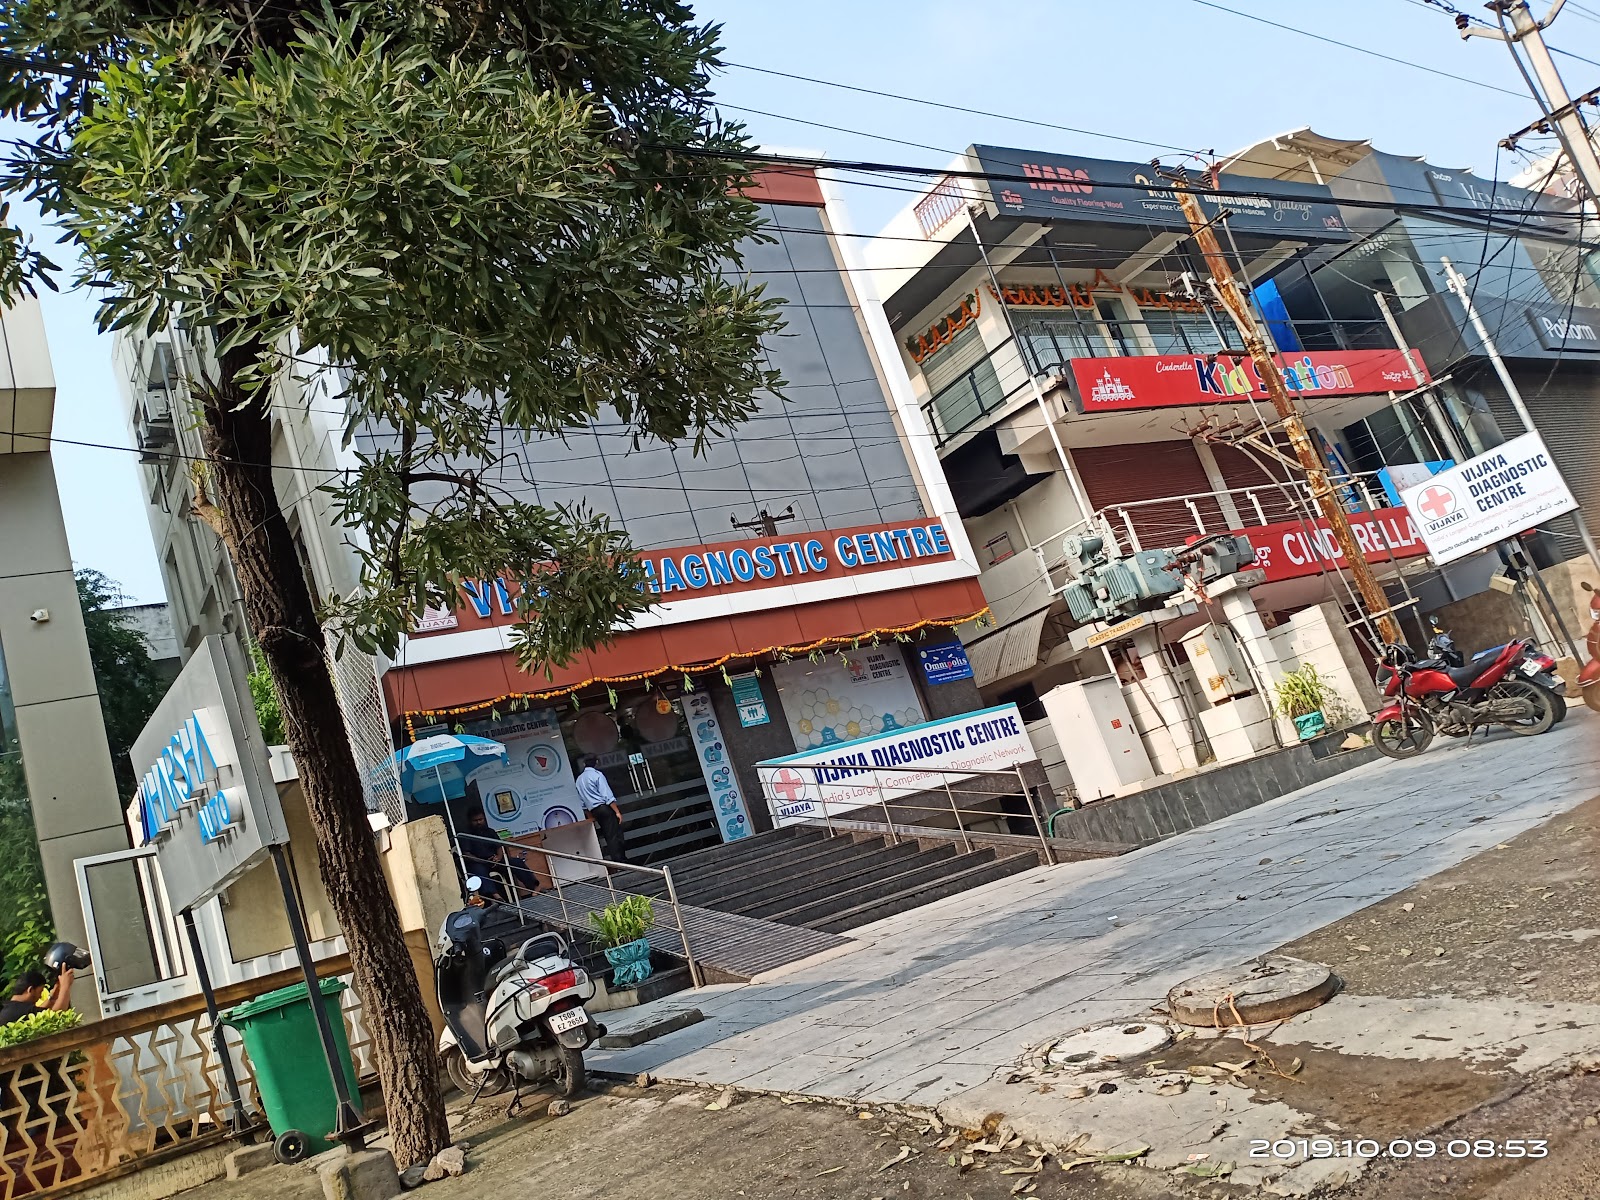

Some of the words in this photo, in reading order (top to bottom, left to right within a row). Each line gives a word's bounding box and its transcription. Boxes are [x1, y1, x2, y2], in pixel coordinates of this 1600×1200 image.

[1022, 163, 1093, 194] HARO
[1051, 196, 1076, 207] Quality
[1156, 359, 1194, 374] Cinderella
[1194, 357, 1253, 397] Kid
[1252, 356, 1354, 394] Sation
[1461, 453, 1508, 483] VIJAYA
[1468, 453, 1548, 498] DIAGNOSTIC
[1476, 481, 1527, 513] CENTRE
[1429, 511, 1464, 531] VIJAYA
[1282, 515, 1426, 566] CINDRELLA
[617, 538, 829, 595] IAGNOSTIC
[834, 523, 950, 568] CENTRE
[866, 653, 886, 663] VIJAYA
[869, 659, 901, 671] DIAGNOSTIC
[872, 669, 892, 679] CENTRE
[812, 752, 871, 785] VIJAYA
[871, 729, 965, 771] DIAGNOSTIC
[965, 715, 1020, 746] CENTRE
[143, 708, 231, 840] HARSHA
[823, 790, 851, 804] ndia's
[851, 782, 883, 798] Larget
[884, 764, 946, 790] Comprehense
[950, 754, 992, 770] Diagnostic
[993, 744, 1026, 758] Network
[198, 788, 245, 846] AUTO
[780, 802, 812, 817] VIJAYA
[557, 1022, 567, 1031] EZ
[567, 1016, 584, 1028] 2650
[558, 1010, 576, 1021] TS09
